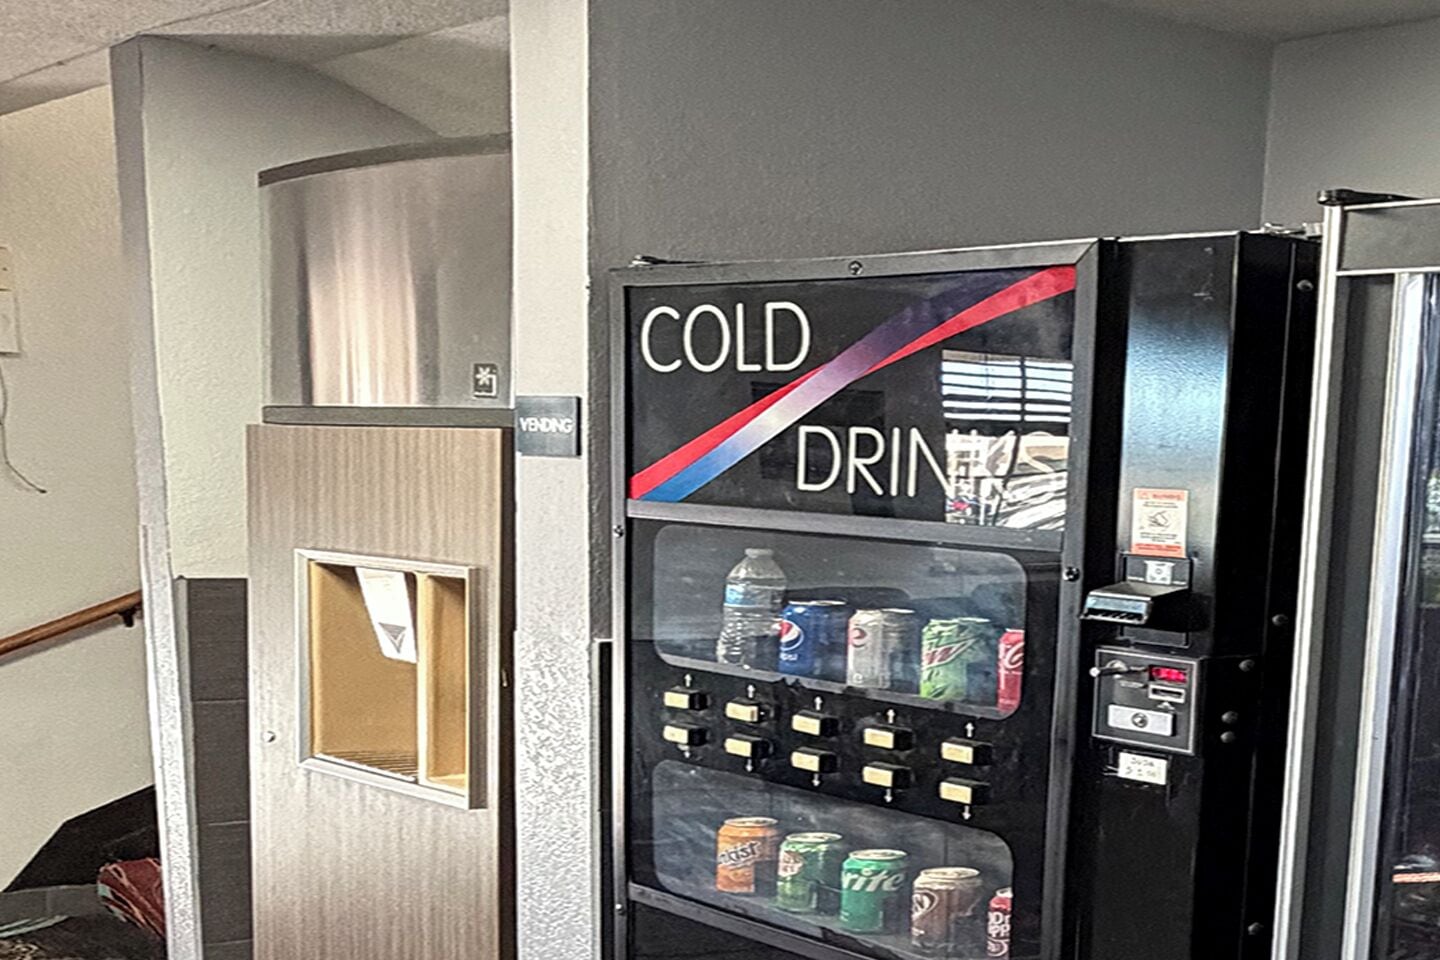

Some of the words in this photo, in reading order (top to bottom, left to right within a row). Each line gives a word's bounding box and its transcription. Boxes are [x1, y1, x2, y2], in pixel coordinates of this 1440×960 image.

[640, 301, 812, 374] COLD
[519, 416, 574, 435] VENDING
[842, 866, 907, 892] rite
